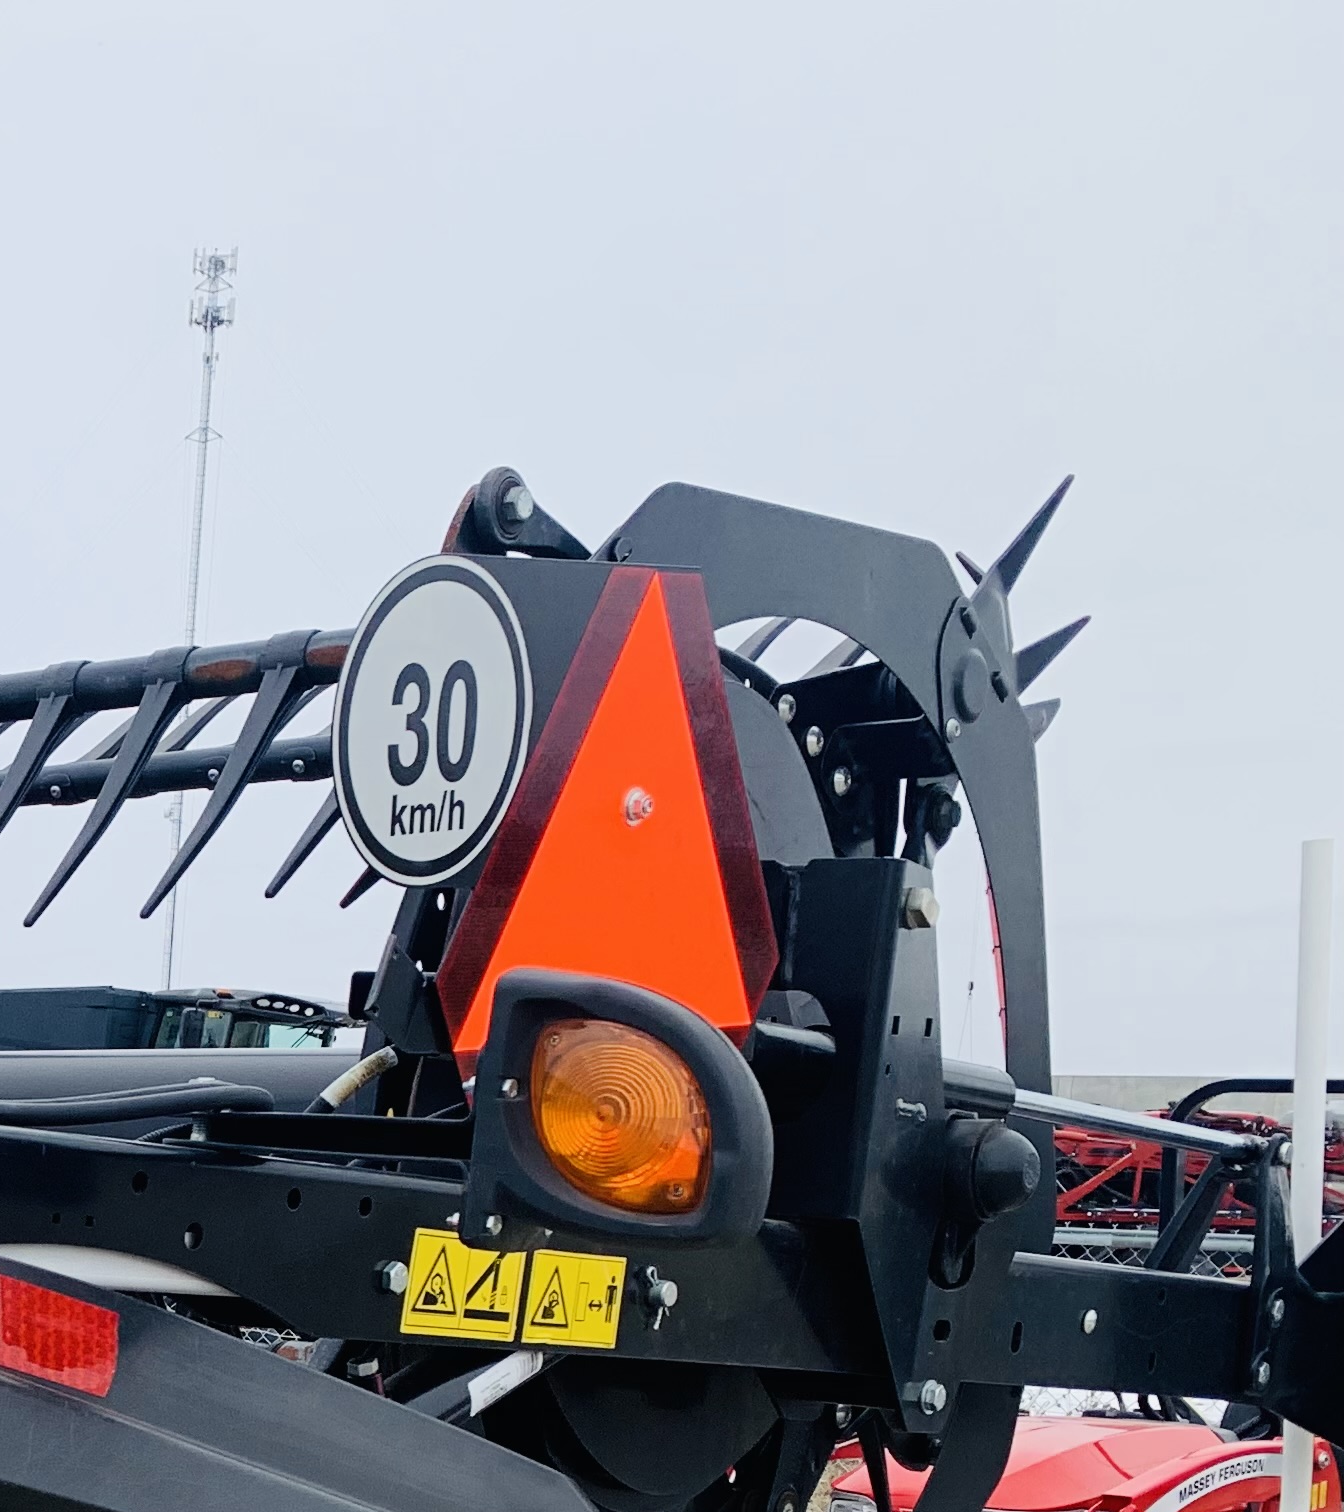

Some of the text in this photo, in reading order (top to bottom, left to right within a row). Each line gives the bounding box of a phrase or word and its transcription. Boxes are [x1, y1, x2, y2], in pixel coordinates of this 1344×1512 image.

[387, 659, 478, 787] 30
[390, 789, 465, 837] km/h
[1178, 1458, 1265, 1503] MASSEY FERGUSON
